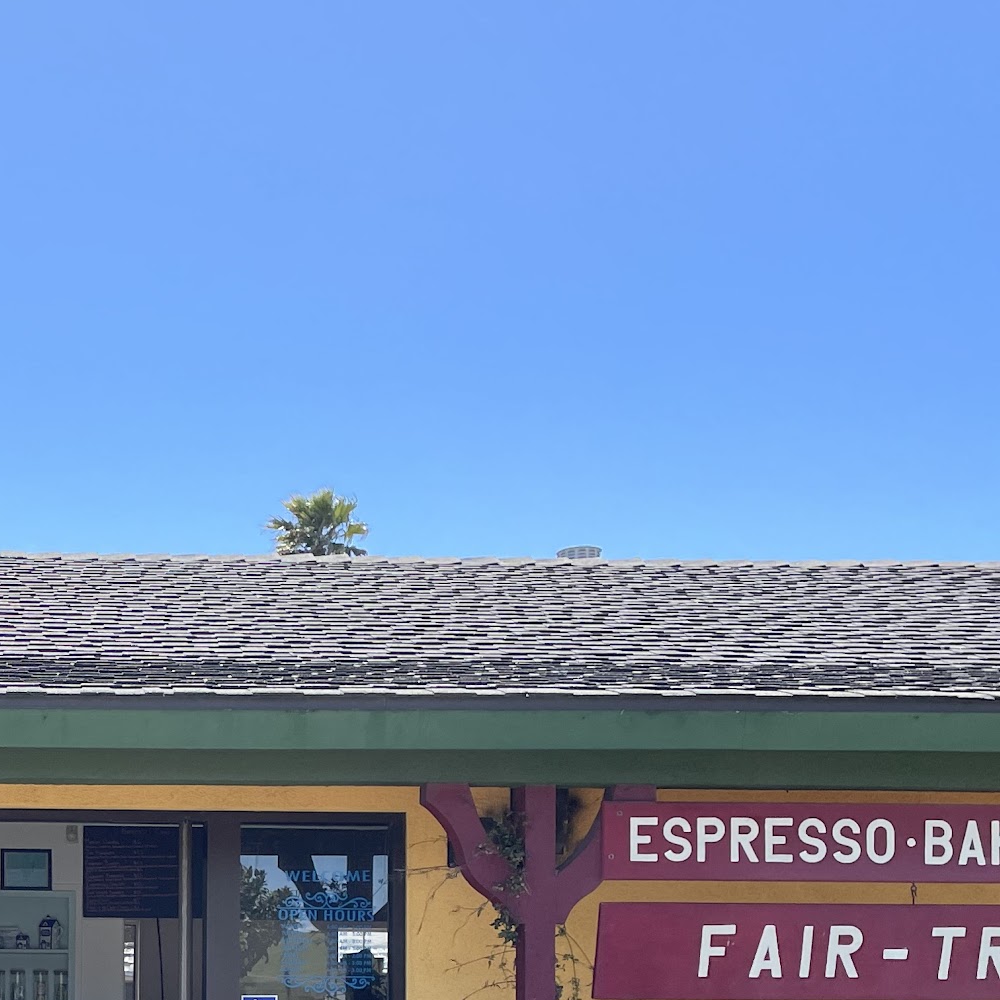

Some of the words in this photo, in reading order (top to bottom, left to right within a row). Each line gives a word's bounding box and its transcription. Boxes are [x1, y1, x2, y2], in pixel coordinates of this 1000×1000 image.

[285, 870, 371, 882] WELCOME
[278, 909, 317, 921] OPEN
[323, 909, 375, 922] HOURS
